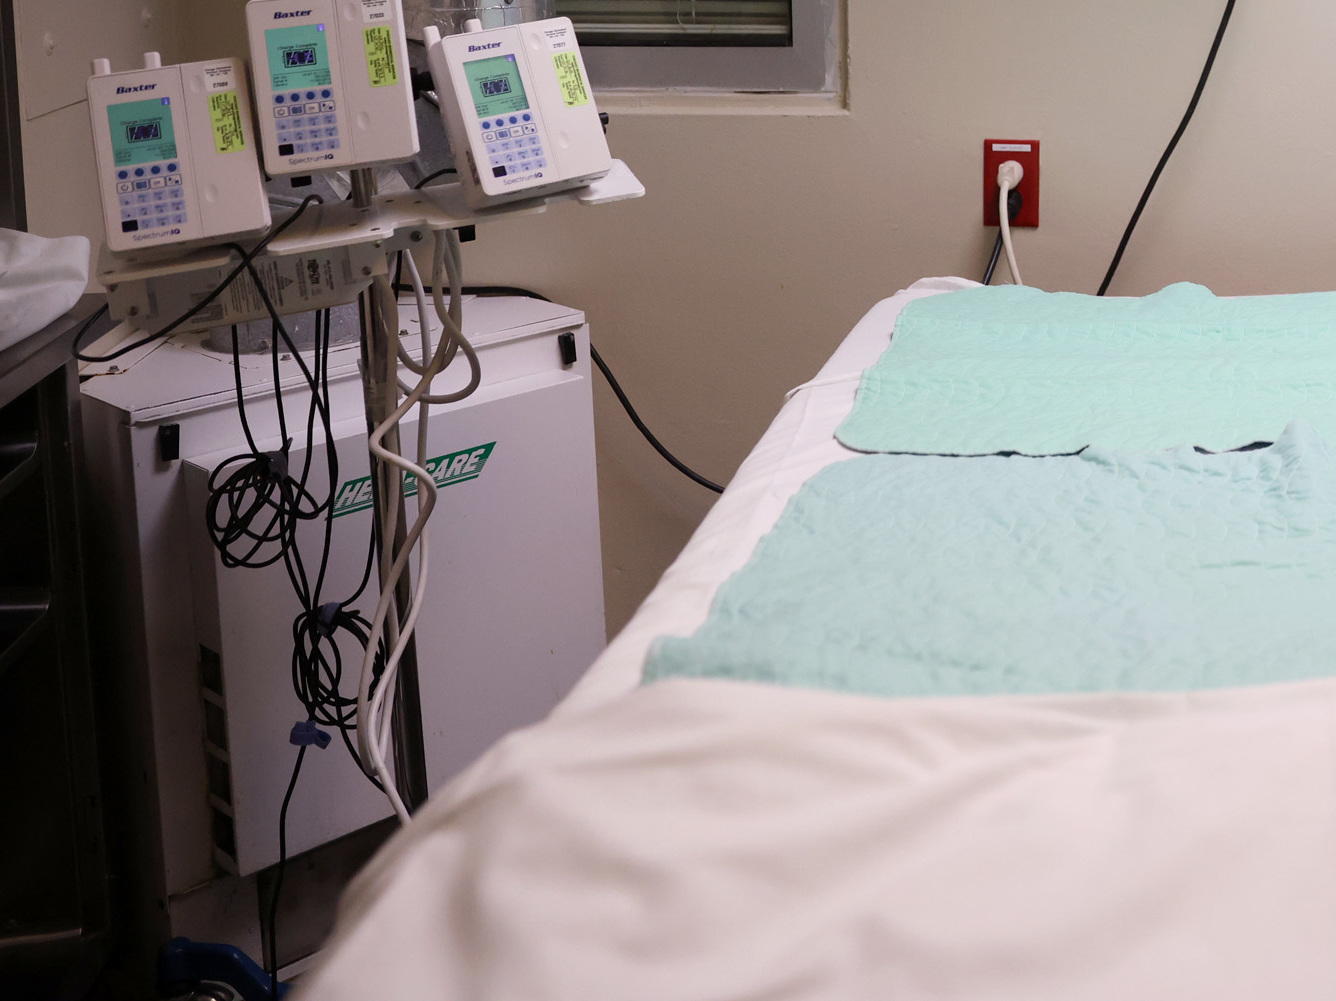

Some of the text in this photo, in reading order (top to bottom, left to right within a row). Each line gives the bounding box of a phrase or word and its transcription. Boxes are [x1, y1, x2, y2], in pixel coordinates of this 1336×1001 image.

[273, 10, 312, 20] Baxter
[468, 41, 502, 53] Baxter
[116, 83, 157, 95] Baxter
